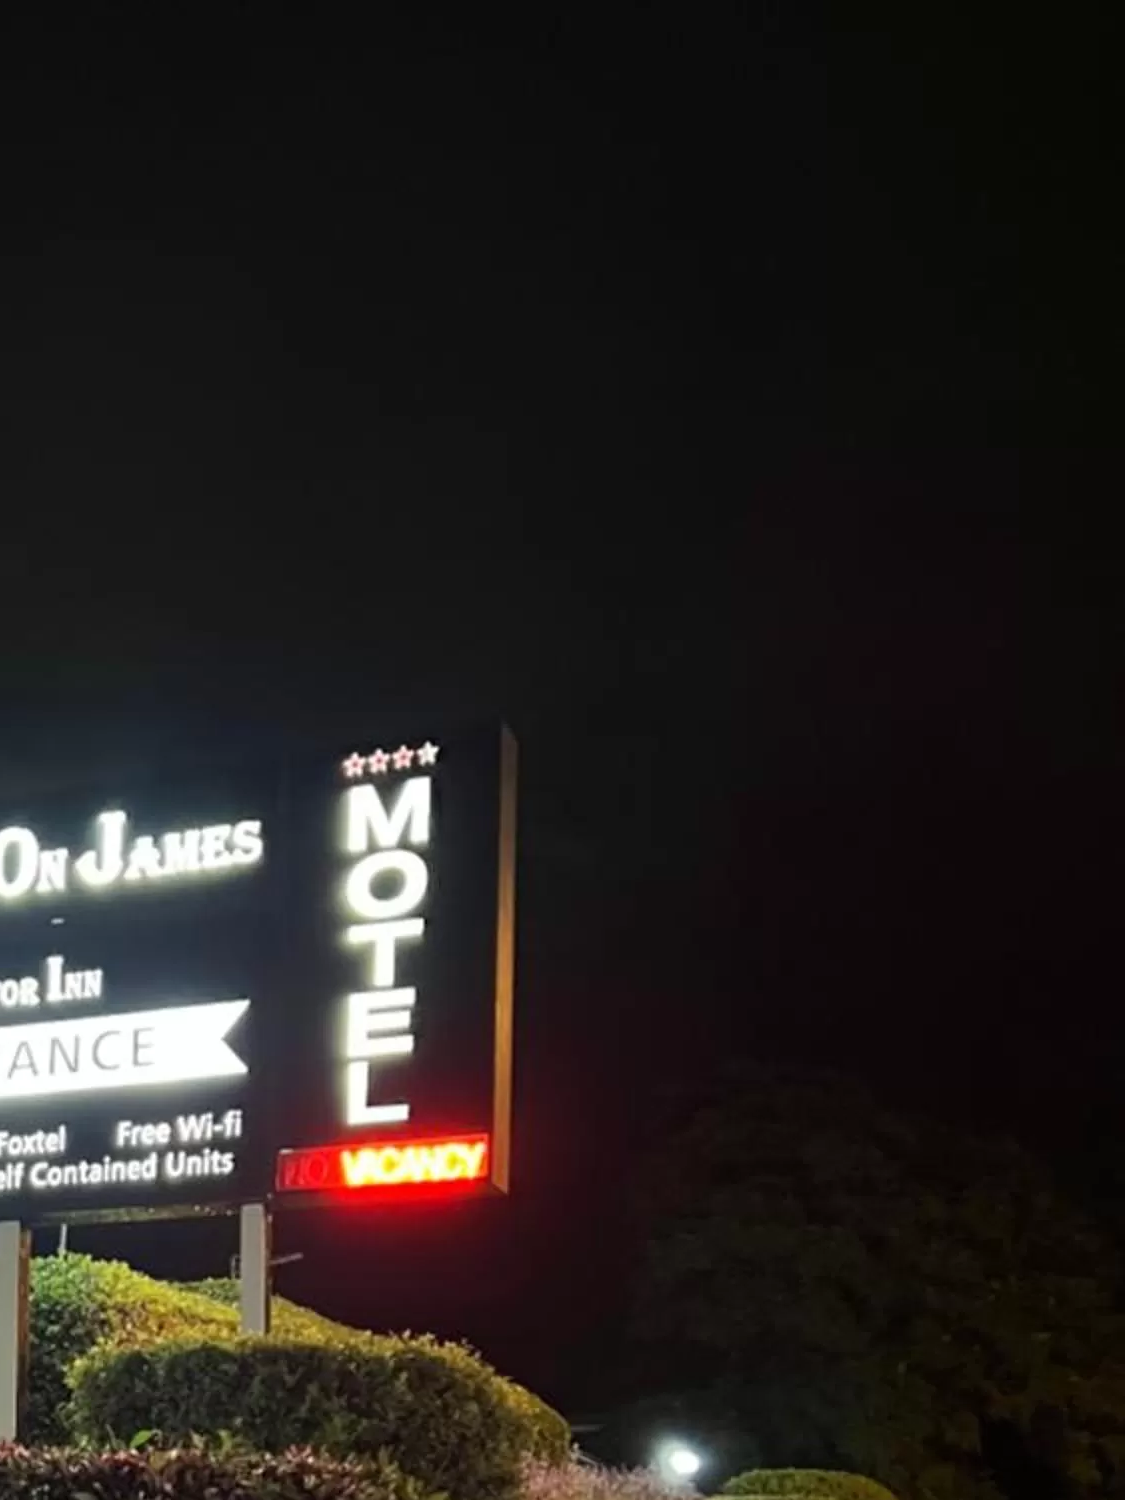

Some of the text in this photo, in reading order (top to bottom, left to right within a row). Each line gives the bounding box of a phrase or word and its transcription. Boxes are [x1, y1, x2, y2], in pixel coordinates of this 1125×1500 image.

[345, 776, 433, 1125] MOTEL
[115, 1109, 244, 1148] Free Wi-fi
[28, 1151, 158, 1188] Contained
[163, 1147, 236, 1180] Units
[283, 1141, 488, 1188] NO VACANCY
